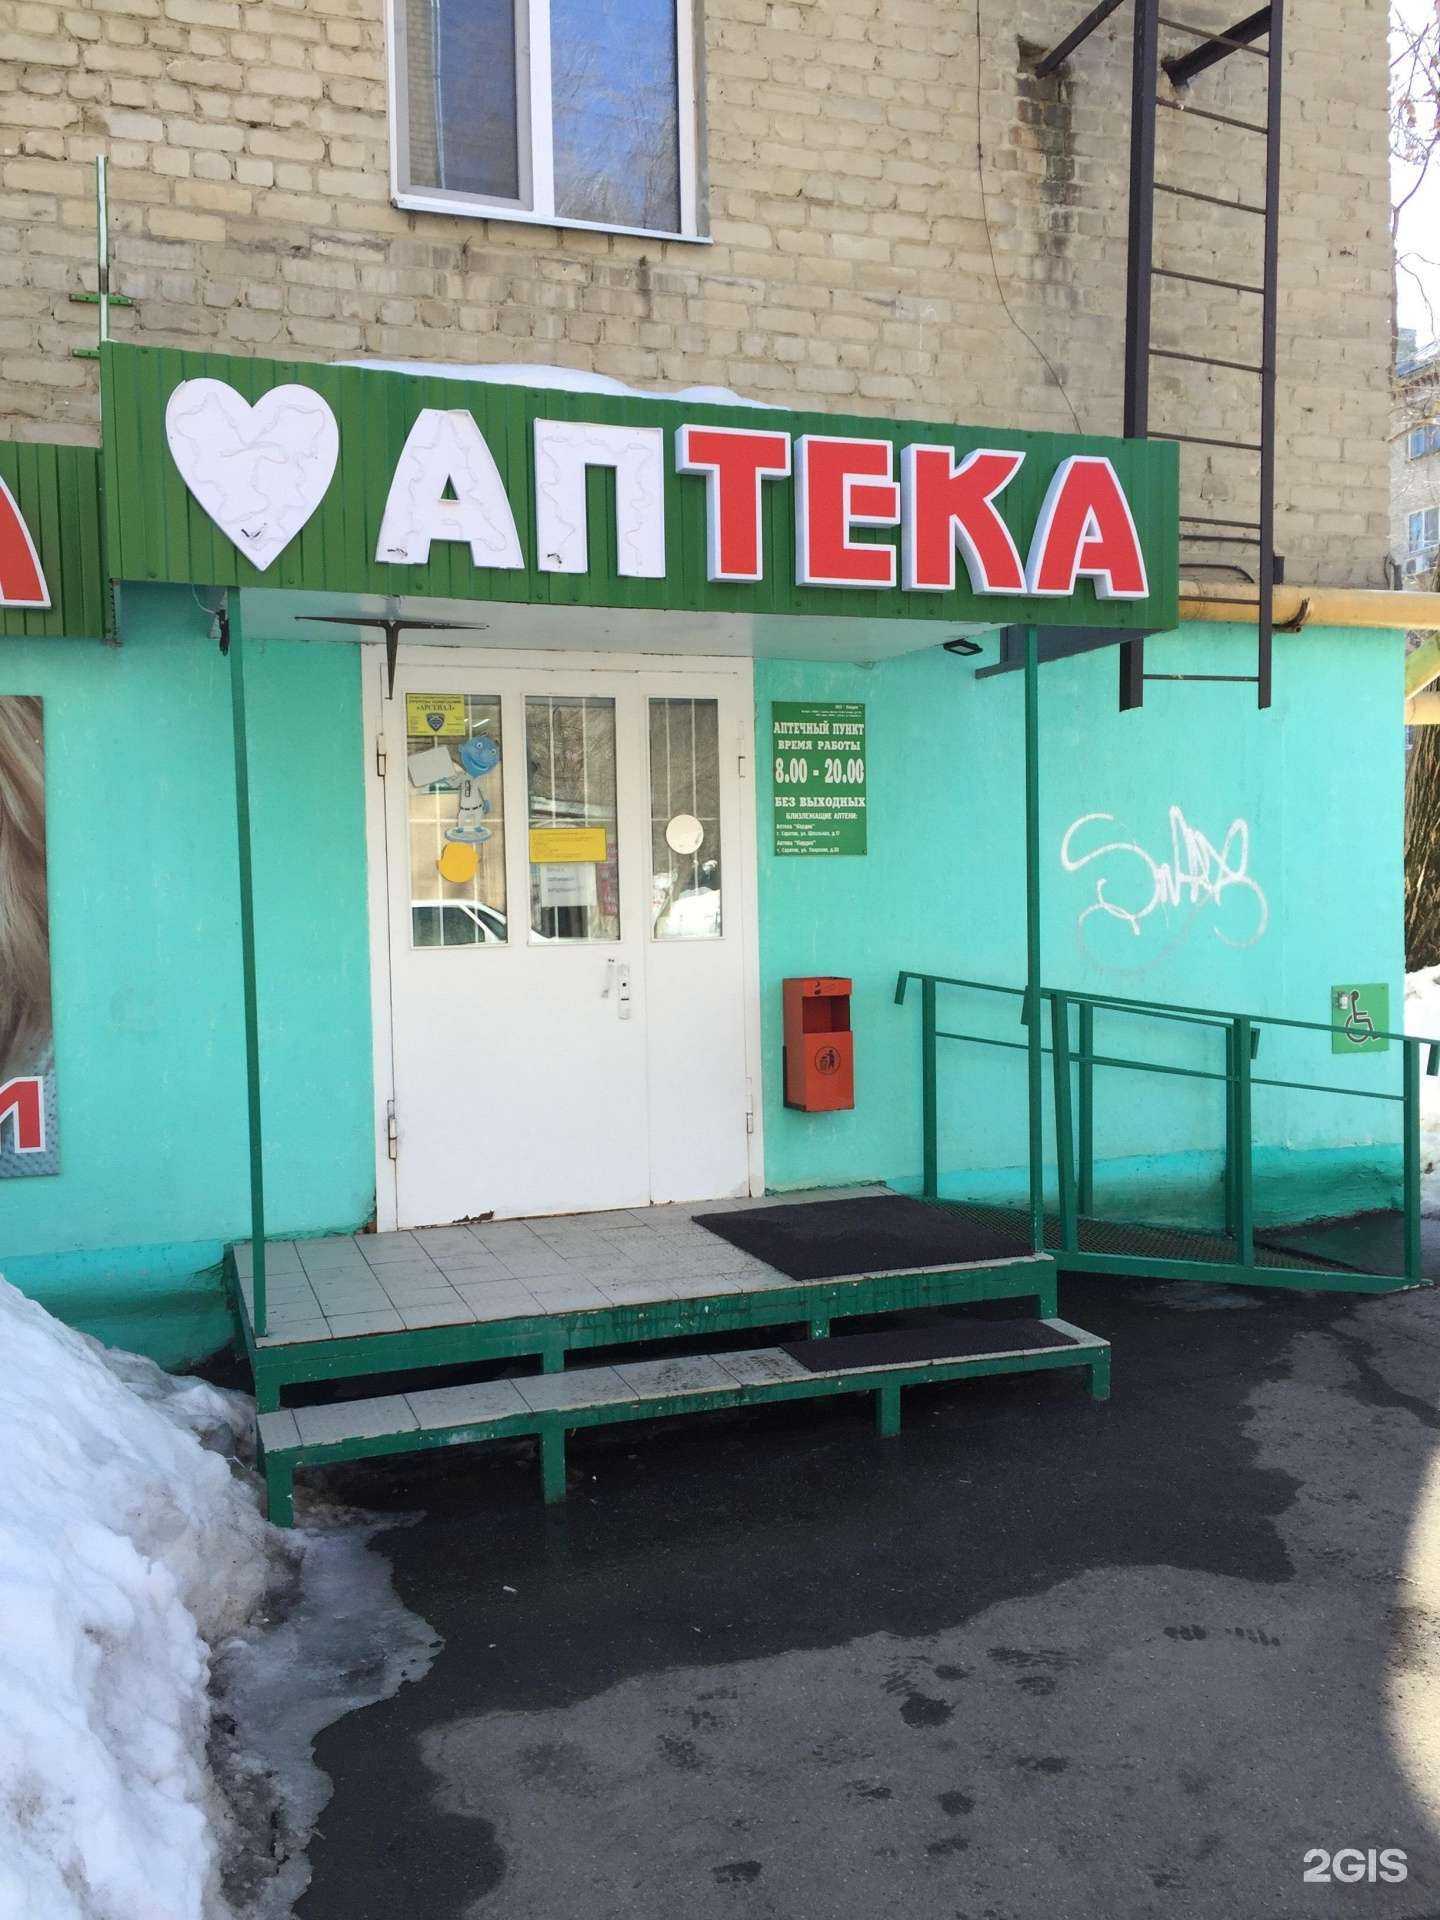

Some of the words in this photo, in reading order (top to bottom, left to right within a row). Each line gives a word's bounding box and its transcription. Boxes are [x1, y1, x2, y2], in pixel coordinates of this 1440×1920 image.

[375, 408, 1149, 599] АПТЕКА
[773, 720, 830, 735] АПТЕЧНЫЙ
[832, 723, 865, 736] ПУНКТ
[778, 740, 813, 750] ВРЕМЯ
[817, 741, 861, 751] РАБОТЫ
[775, 757, 808, 784] 8.00
[824, 758, 865, 784] 20.00
[775, 797, 796, 807] БЕЗ
[800, 797, 866, 808] ВЫХОДНЫХ
